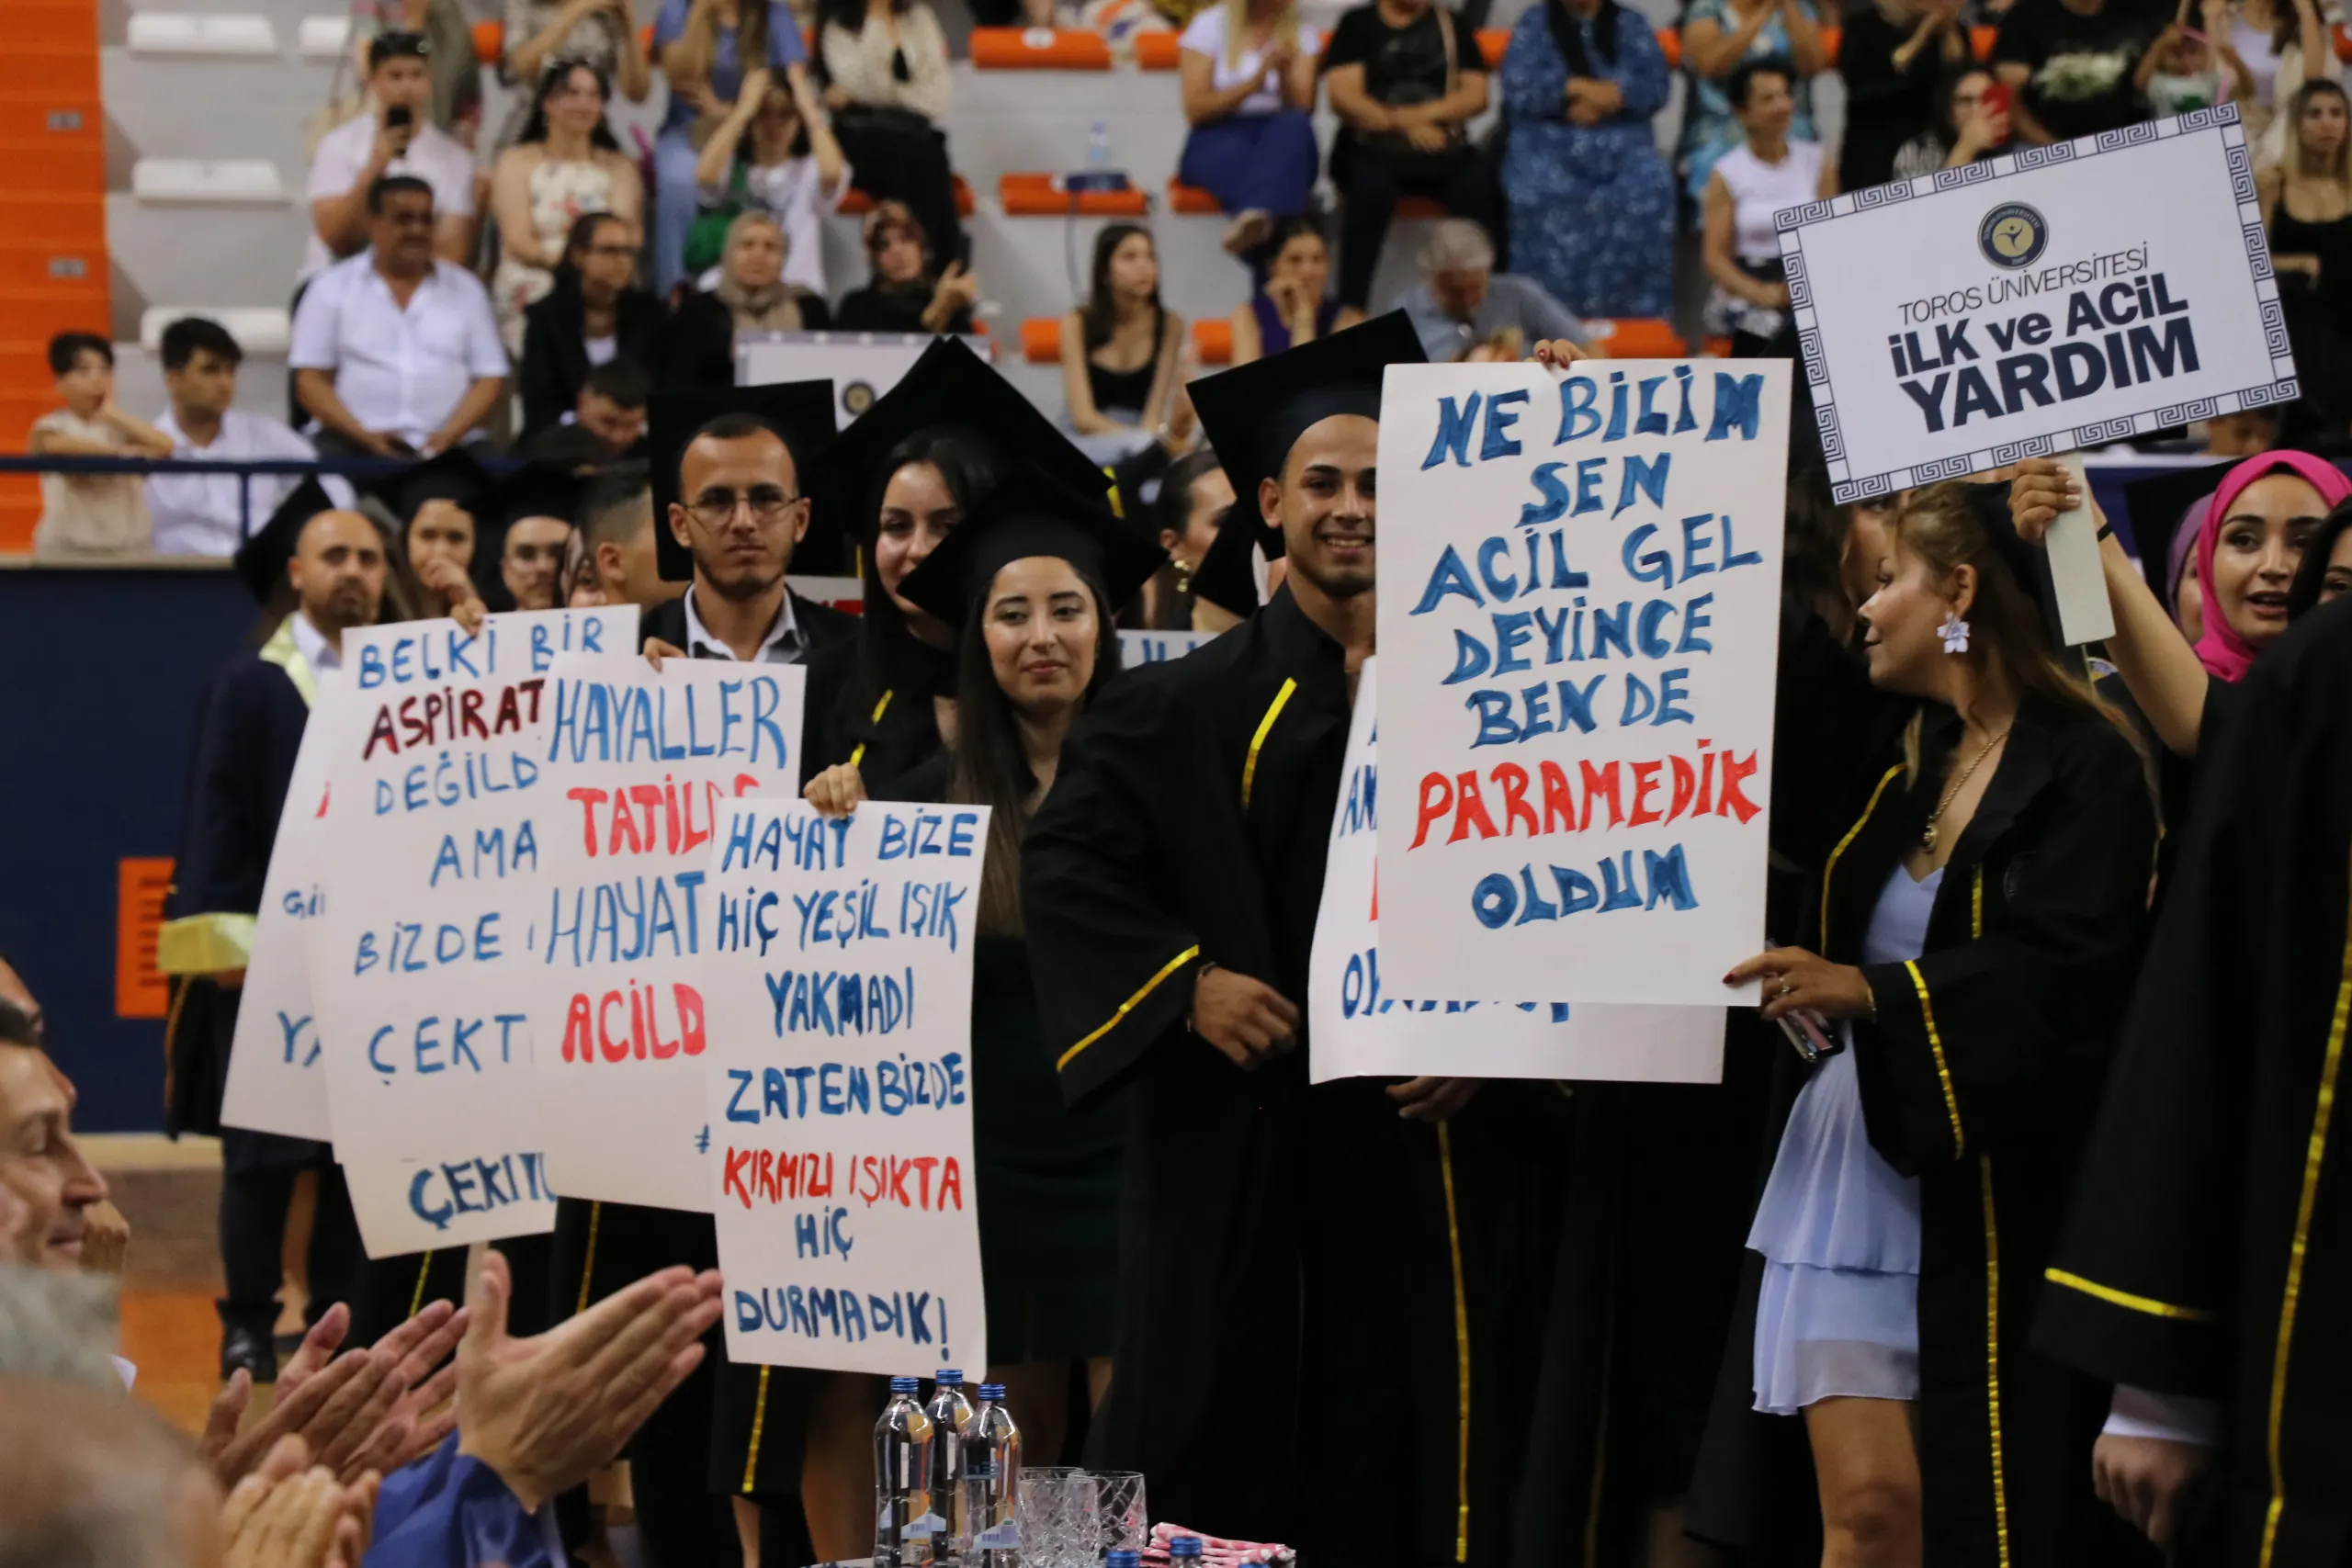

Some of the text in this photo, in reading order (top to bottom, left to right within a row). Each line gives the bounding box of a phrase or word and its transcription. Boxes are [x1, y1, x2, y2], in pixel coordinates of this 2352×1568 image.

[1898, 241, 2149, 326] TOROS ÜNİVERSİTESİ
[1985, 312, 2052, 354] ve
[1900, 317, 2200, 434] YARDIM
[1420, 365, 1765, 471] NE BİLİM
[1514, 451, 1672, 529] SEN
[1408, 512, 1764, 616] ACİL GEL
[357, 614, 604, 690] BELKİ BİR
[1440, 591, 1714, 687] DEYİNCE
[547, 675, 788, 771] HAYALLER
[1464, 667, 1696, 750] BEN DE
[1407, 738, 1764, 853] PARAMEDİK
[429, 818, 538, 888] AMA
[721, 807, 979, 874] HAYAT BİZE
[545, 870, 707, 967] HAYAT
[717, 878, 967, 957] HİÇ YEŞİL IŞIK
[1471, 841, 1701, 931] OLDUM
[354, 911, 503, 976] BİZDE
[763, 965, 914, 1039] YAKMADI
[723, 1145, 965, 1212] KIRMIZI IŞIKTA
[794, 1204, 854, 1262] HİÇ
[734, 1283, 950, 1361] DURMADIK!
